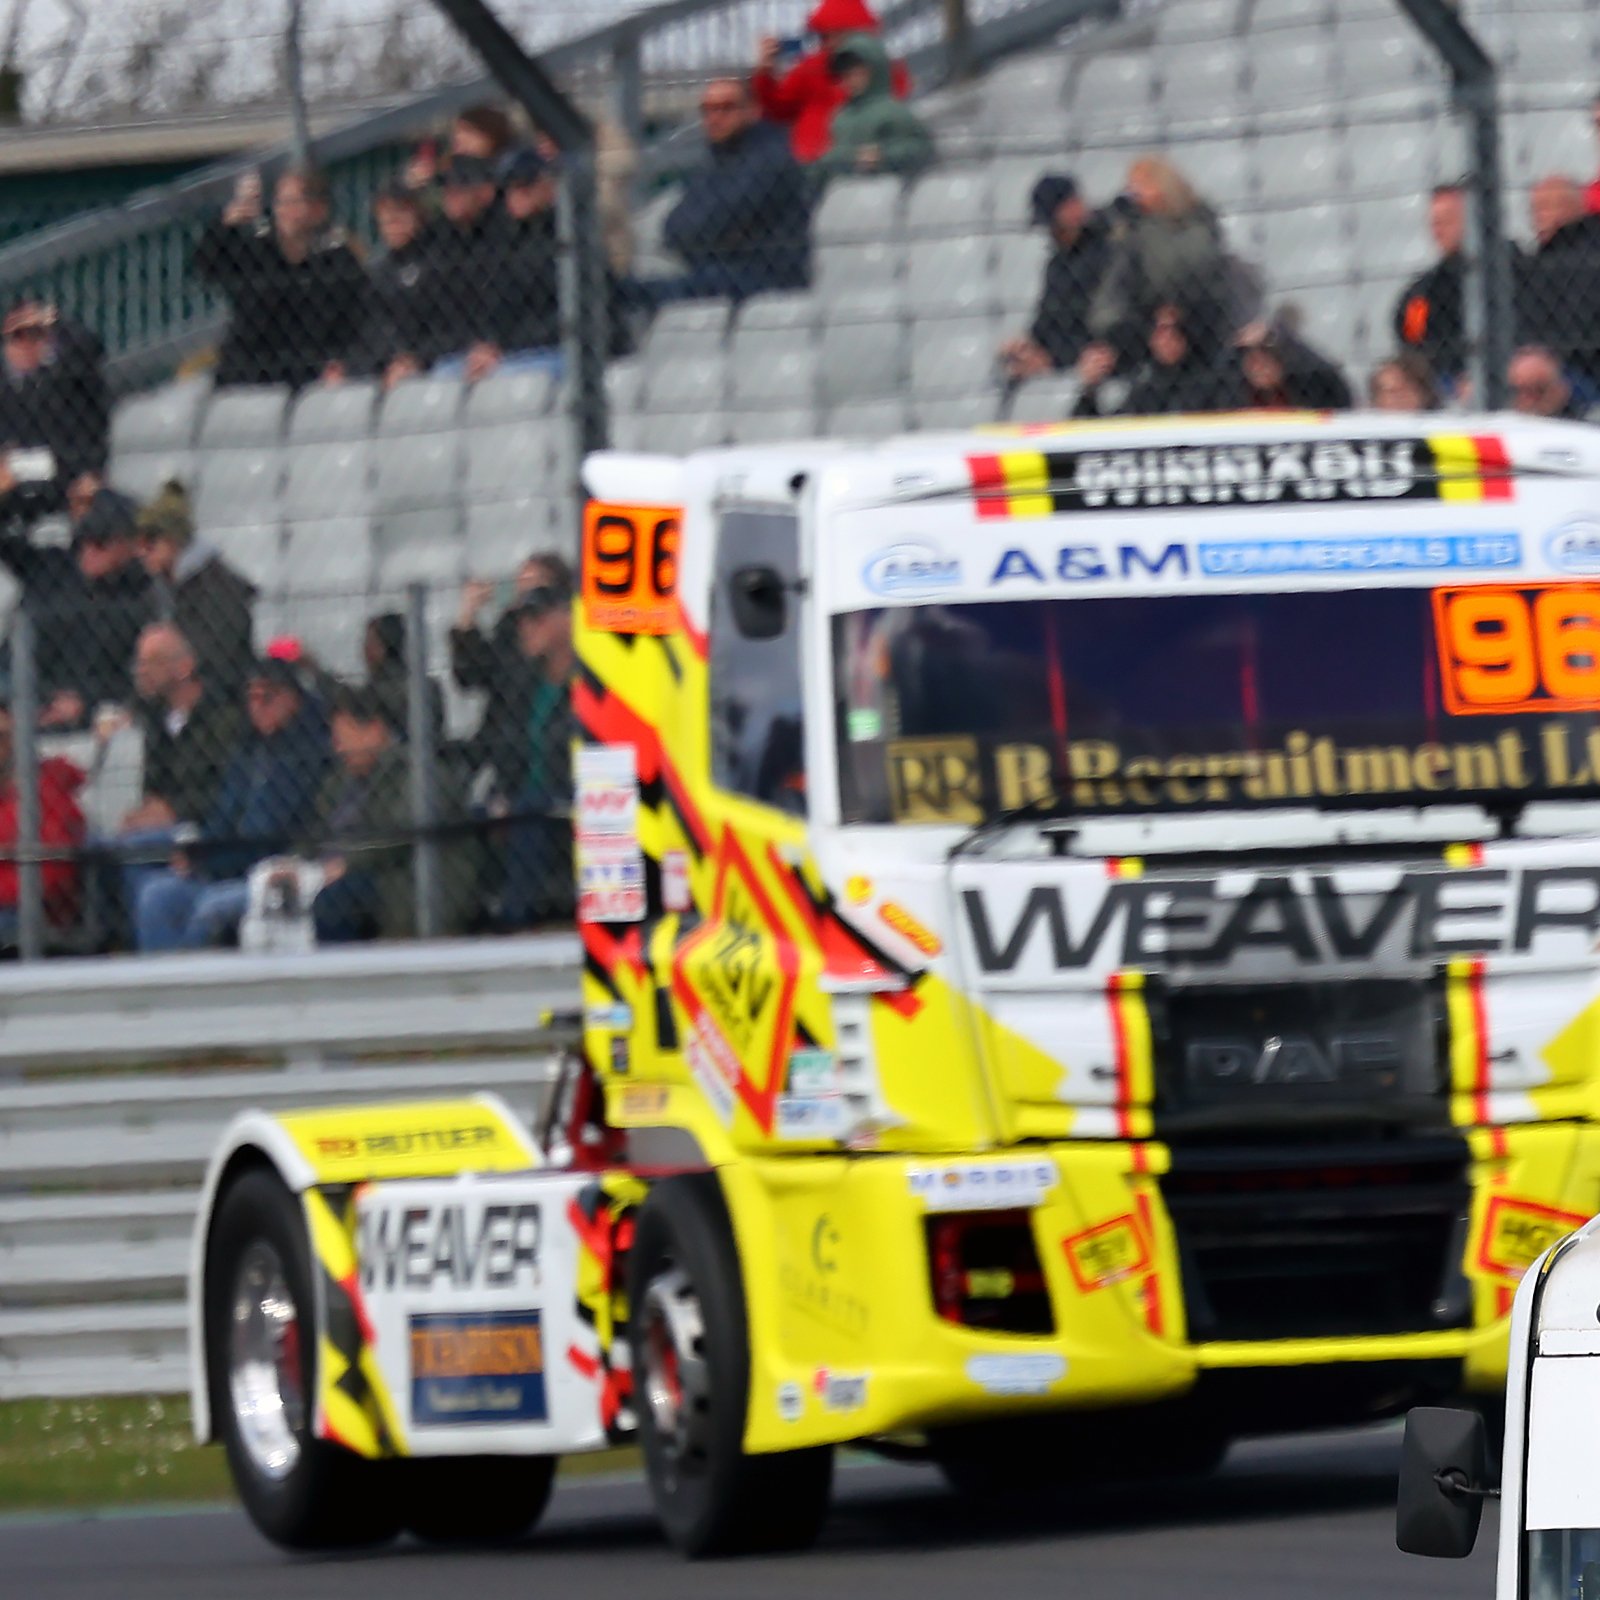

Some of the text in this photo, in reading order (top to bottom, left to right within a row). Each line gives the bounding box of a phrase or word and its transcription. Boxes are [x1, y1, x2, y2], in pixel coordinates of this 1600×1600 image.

[990, 543, 1190, 585] A&M
[1455, 536, 1519, 568] LTD
[1068, 726, 1532, 807] Recruitment
[360, 1203, 544, 1294] WEAVER
